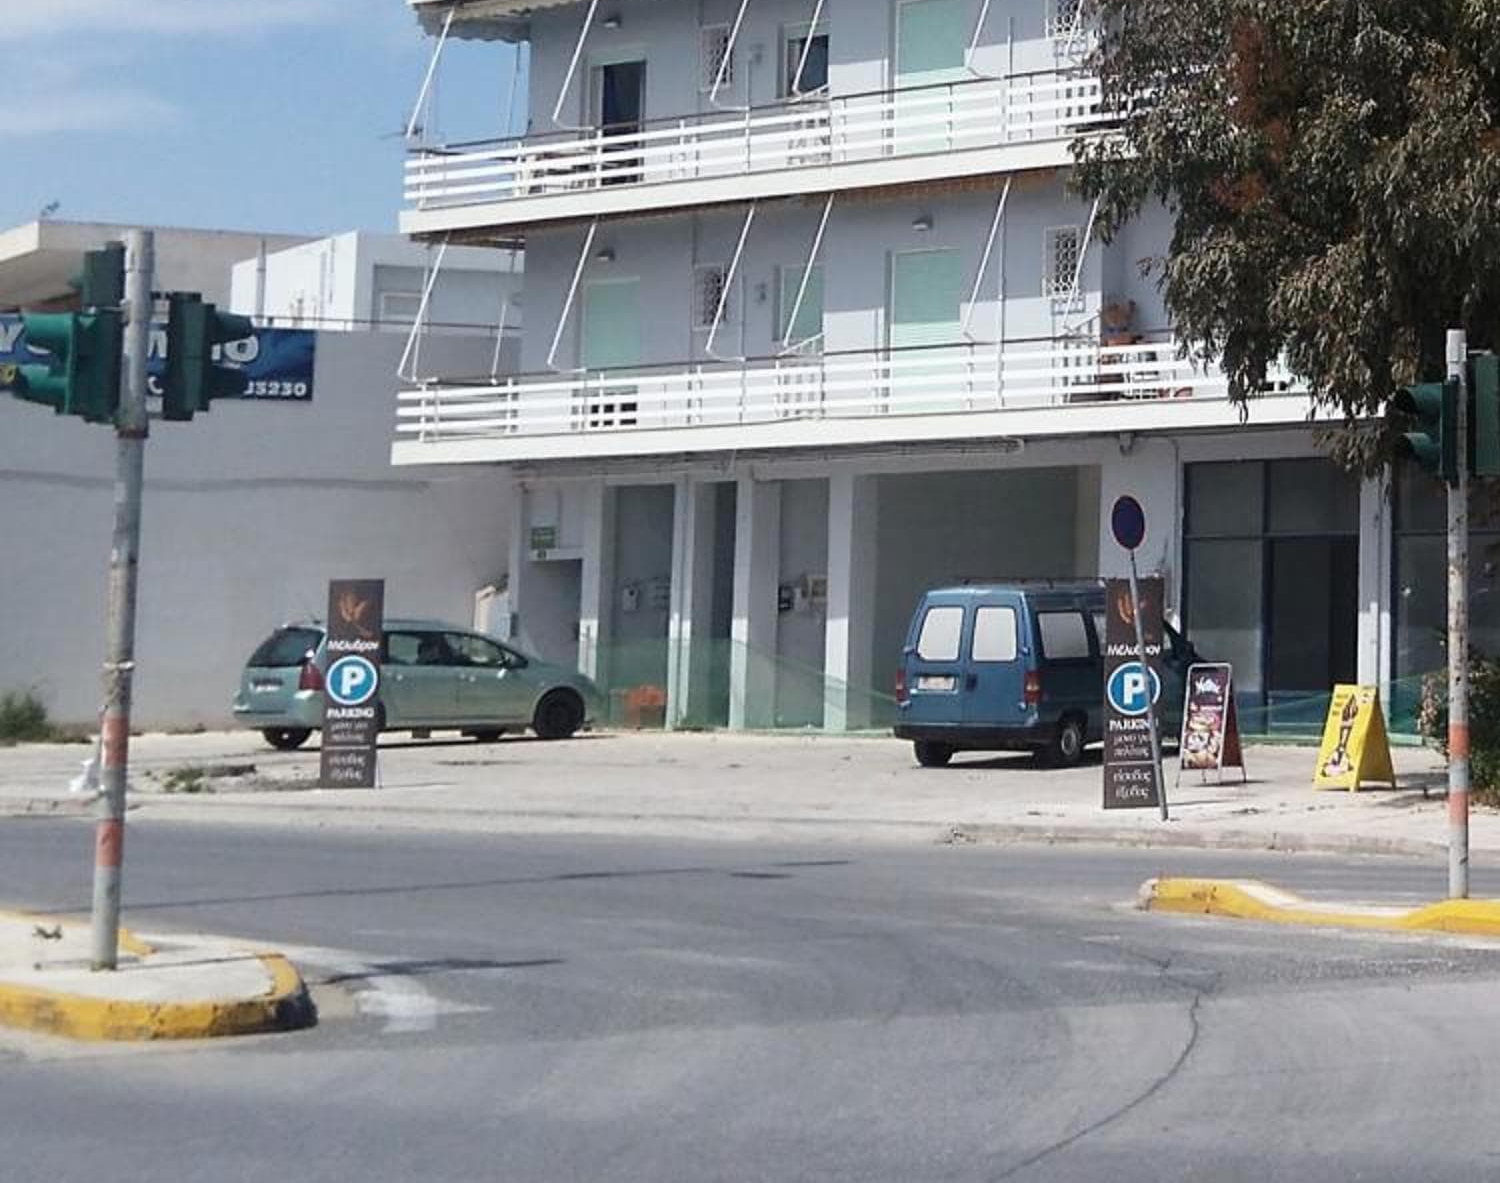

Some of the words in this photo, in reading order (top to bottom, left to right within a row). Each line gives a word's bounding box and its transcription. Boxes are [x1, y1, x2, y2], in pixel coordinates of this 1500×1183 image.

[341, 665, 366, 696] P
[1123, 673, 1145, 705] P
[326, 707, 375, 719] PARKING
[1109, 718, 1158, 731] PARKIN
